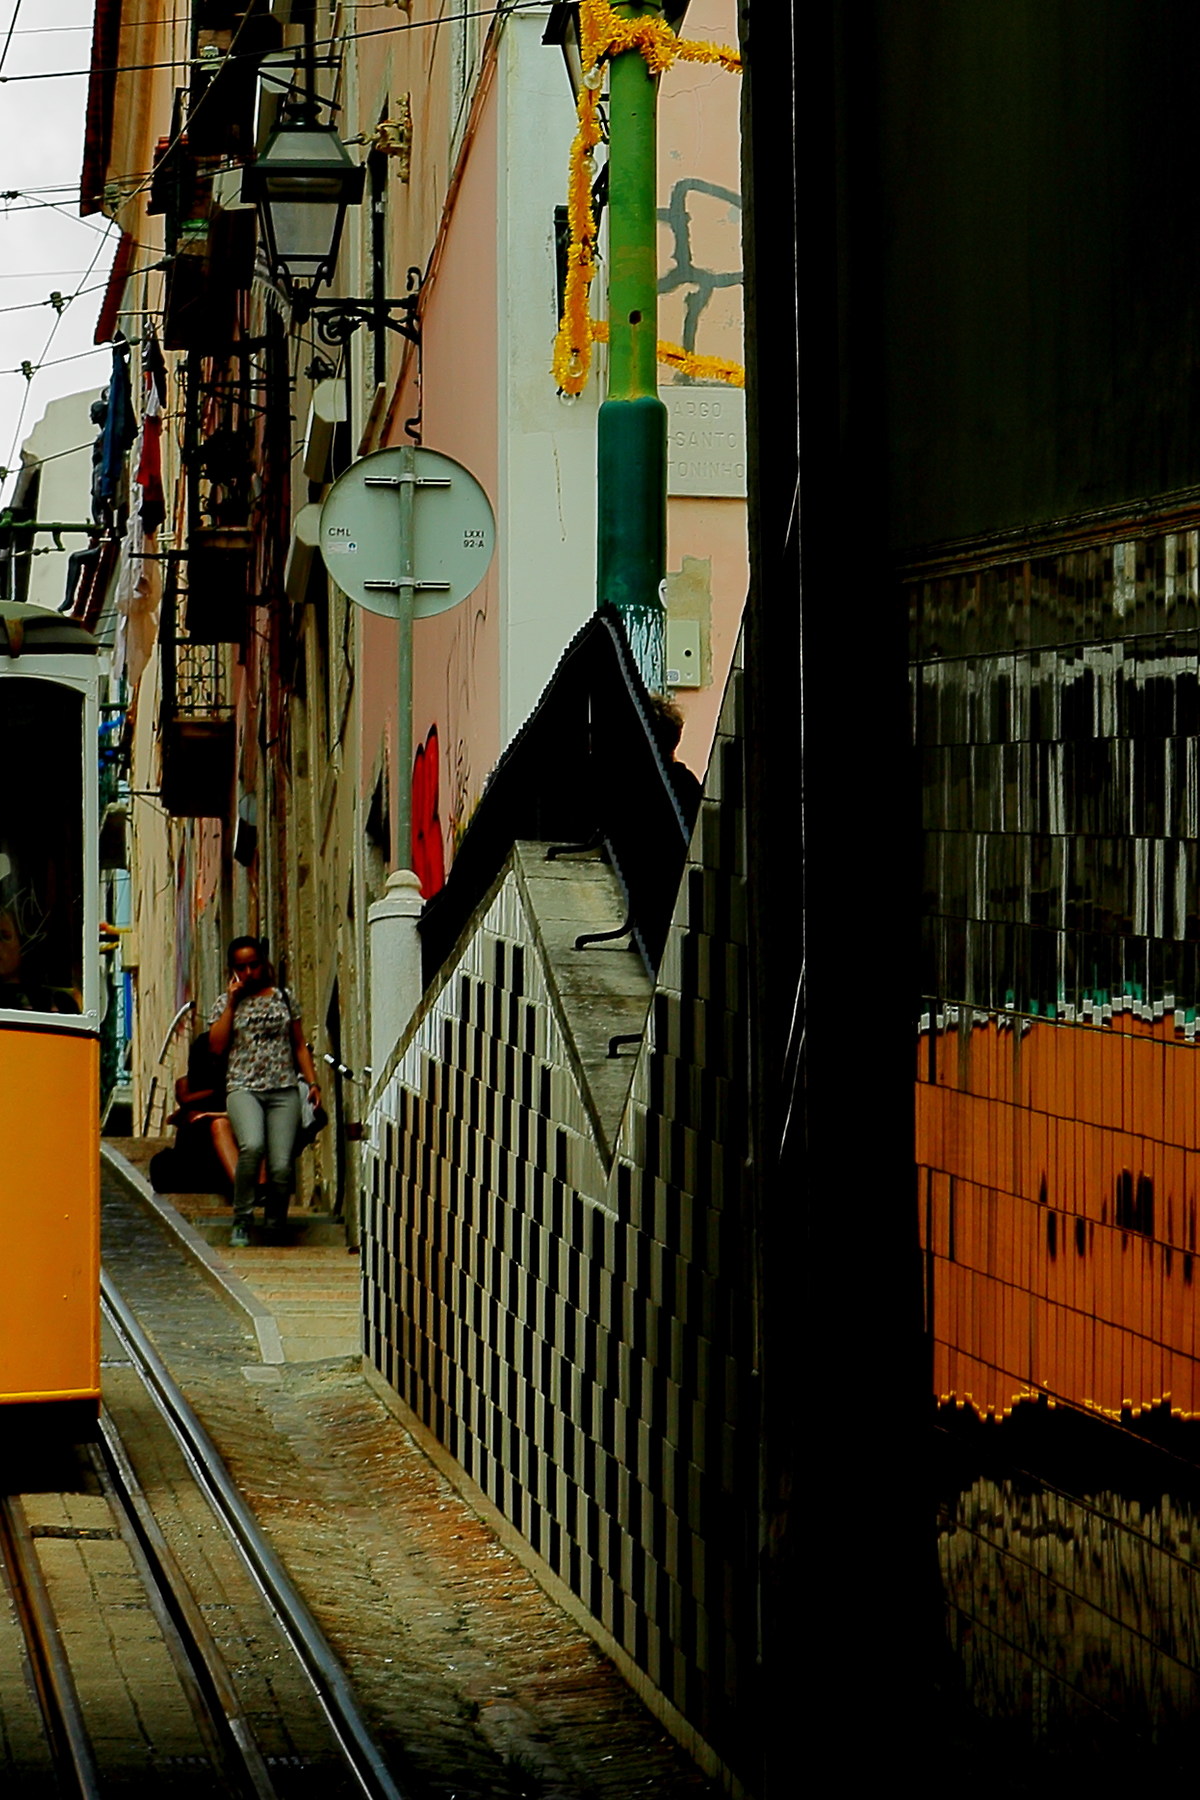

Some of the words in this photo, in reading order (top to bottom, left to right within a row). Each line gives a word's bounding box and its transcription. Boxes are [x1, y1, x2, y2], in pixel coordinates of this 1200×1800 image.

[675, 431, 738, 448] SANTO
[667, 460, 745, 479] TONINHO
[327, 527, 352, 537] CML
[464, 529, 485, 538] LXXI
